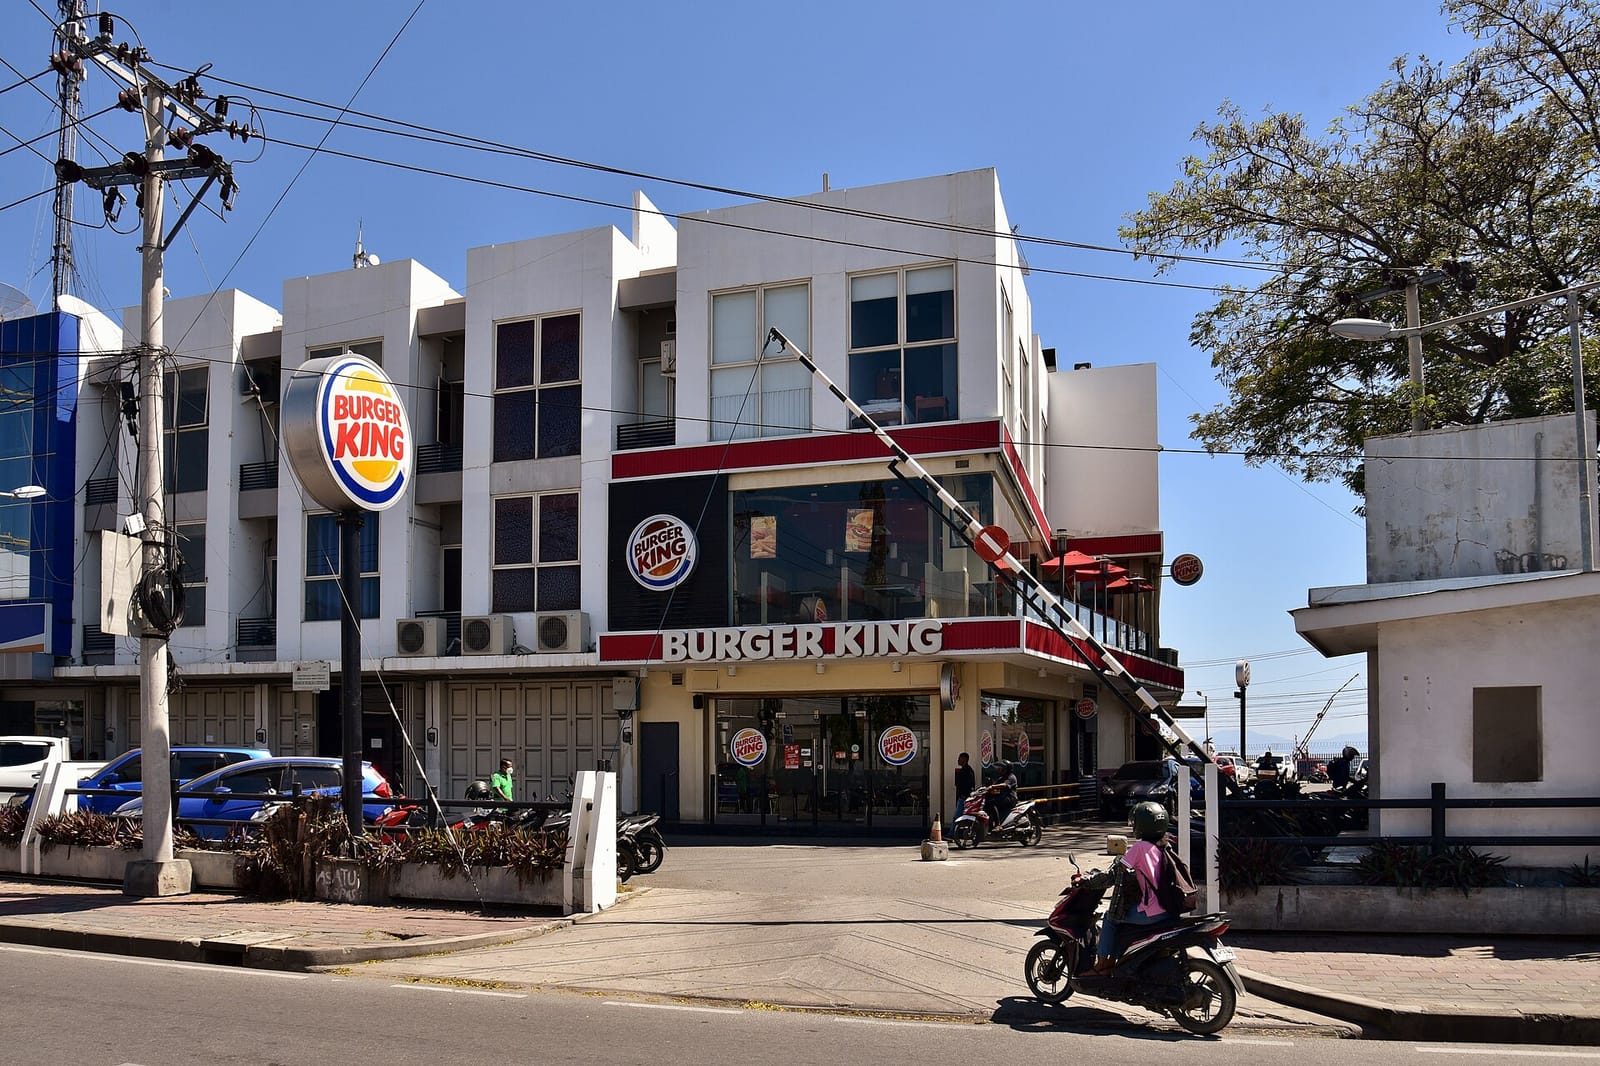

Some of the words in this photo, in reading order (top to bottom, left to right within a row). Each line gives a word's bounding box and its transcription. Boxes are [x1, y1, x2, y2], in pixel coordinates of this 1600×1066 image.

[334, 394, 401, 427] BURGER
[335, 422, 404, 460] KING
[634, 526, 683, 558] BURGER
[637, 537, 687, 575] KING
[1175, 564, 1199, 578] KING
[662, 625, 823, 662] BURGER
[834, 619, 943, 658] KING
[735, 735, 762, 748] BURGER
[736, 741, 763, 757] KING
[883, 733, 912, 748] BURGER
[884, 739, 914, 756] KING
